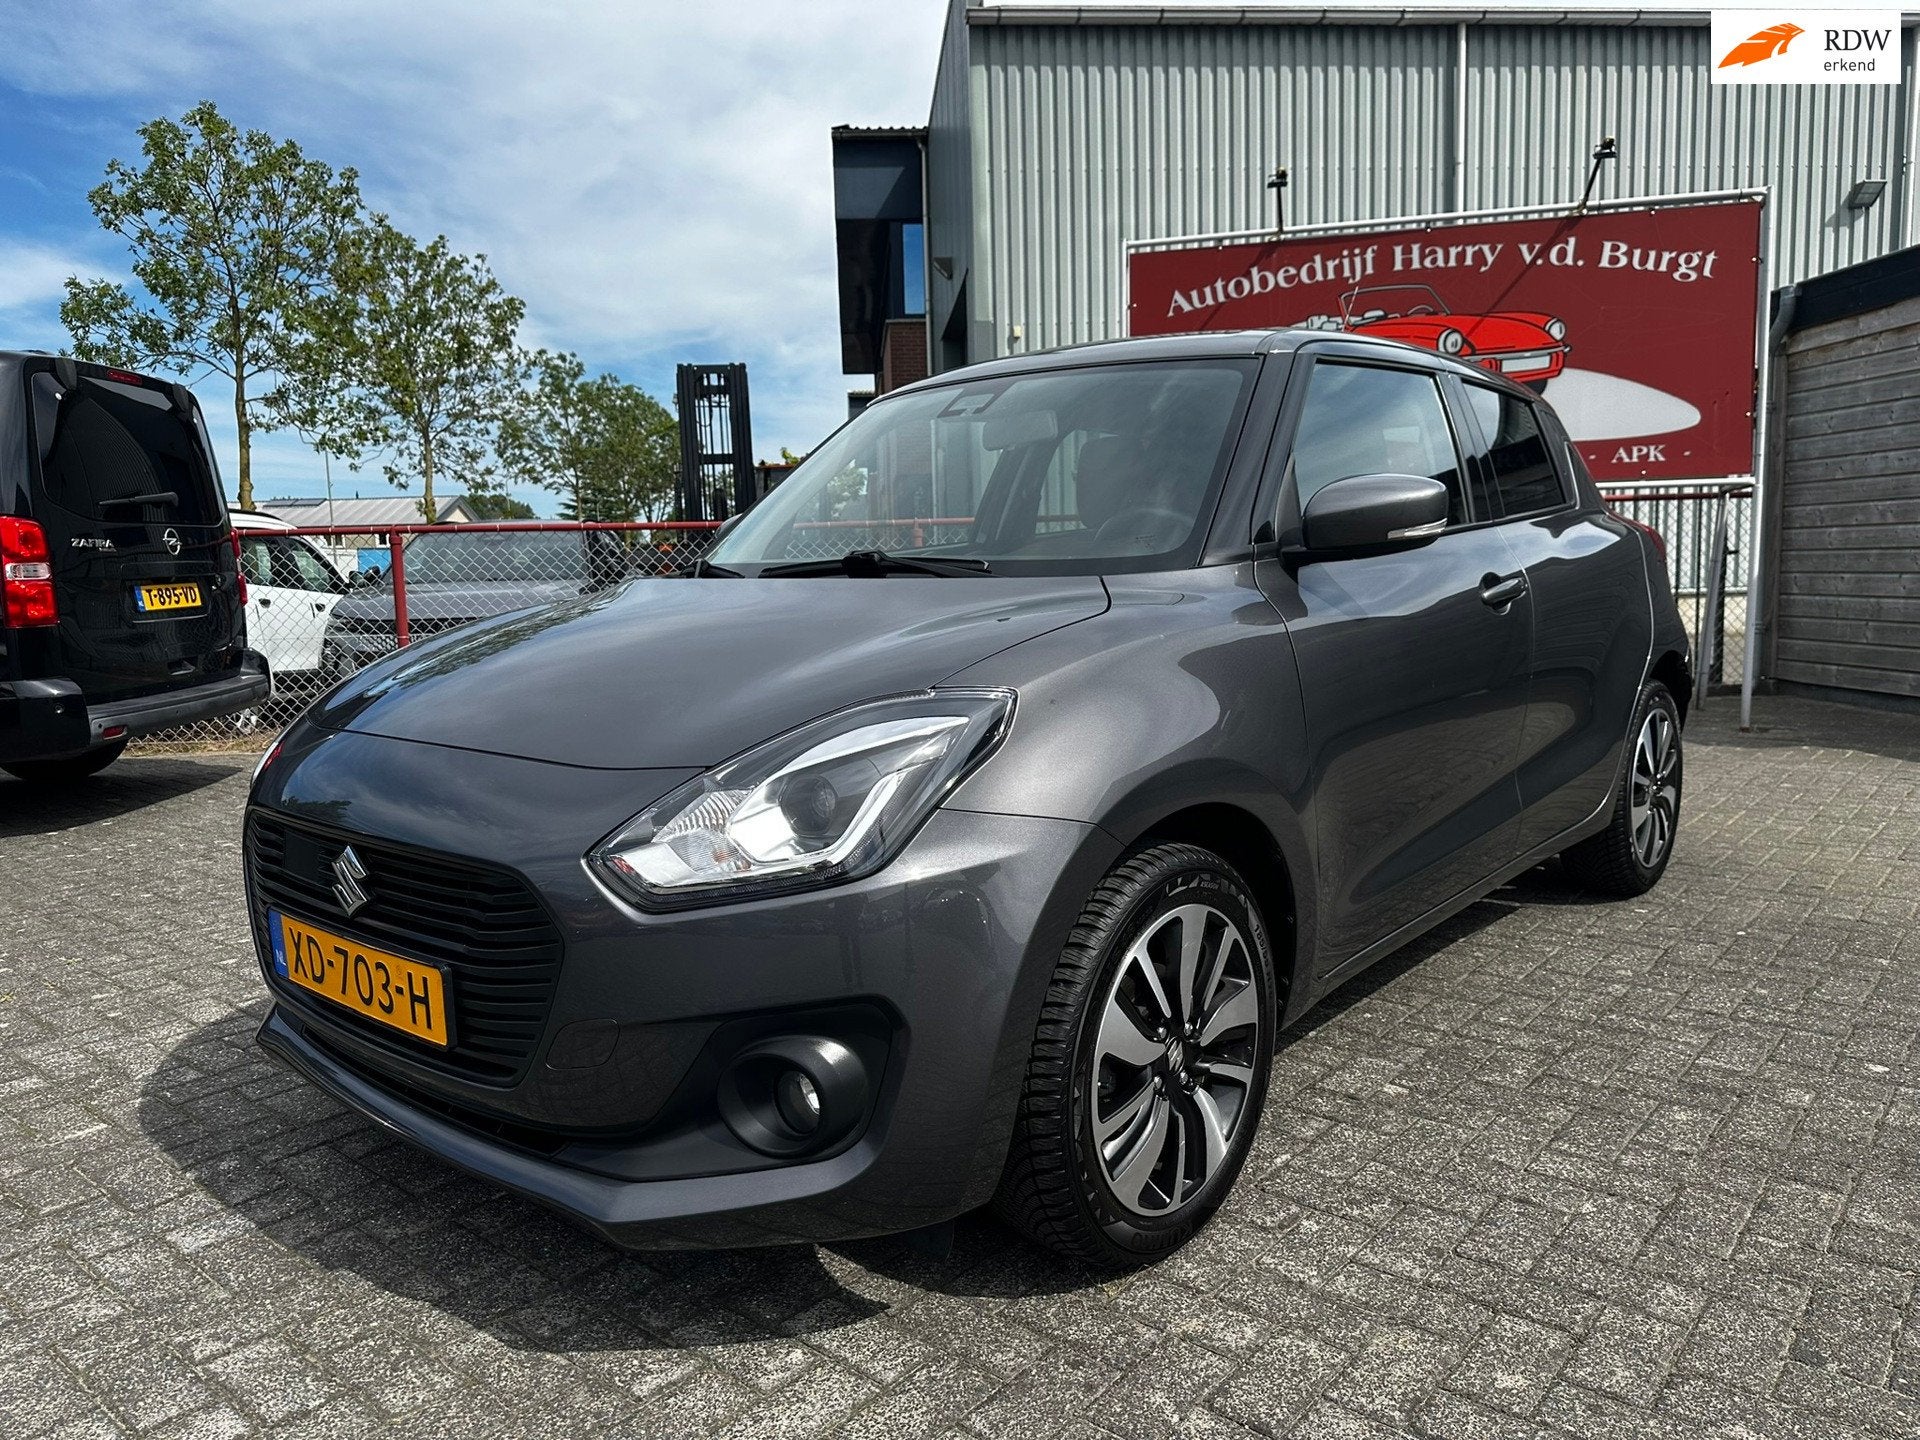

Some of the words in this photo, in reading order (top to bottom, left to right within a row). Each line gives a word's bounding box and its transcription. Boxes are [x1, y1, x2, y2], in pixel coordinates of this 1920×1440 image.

[1167, 244, 1378, 317] Autobedrijf
[1392, 242, 1504, 272] Harry
[1518, 237, 1585, 266] v.d.
[1598, 240, 1719, 282] Burgt
[1611, 444, 1666, 464] APK
[71, 538, 115, 549] ZAFIRA
[146, 586, 197, 606] T-895-VD
[289, 926, 433, 1030] XD-703-H
